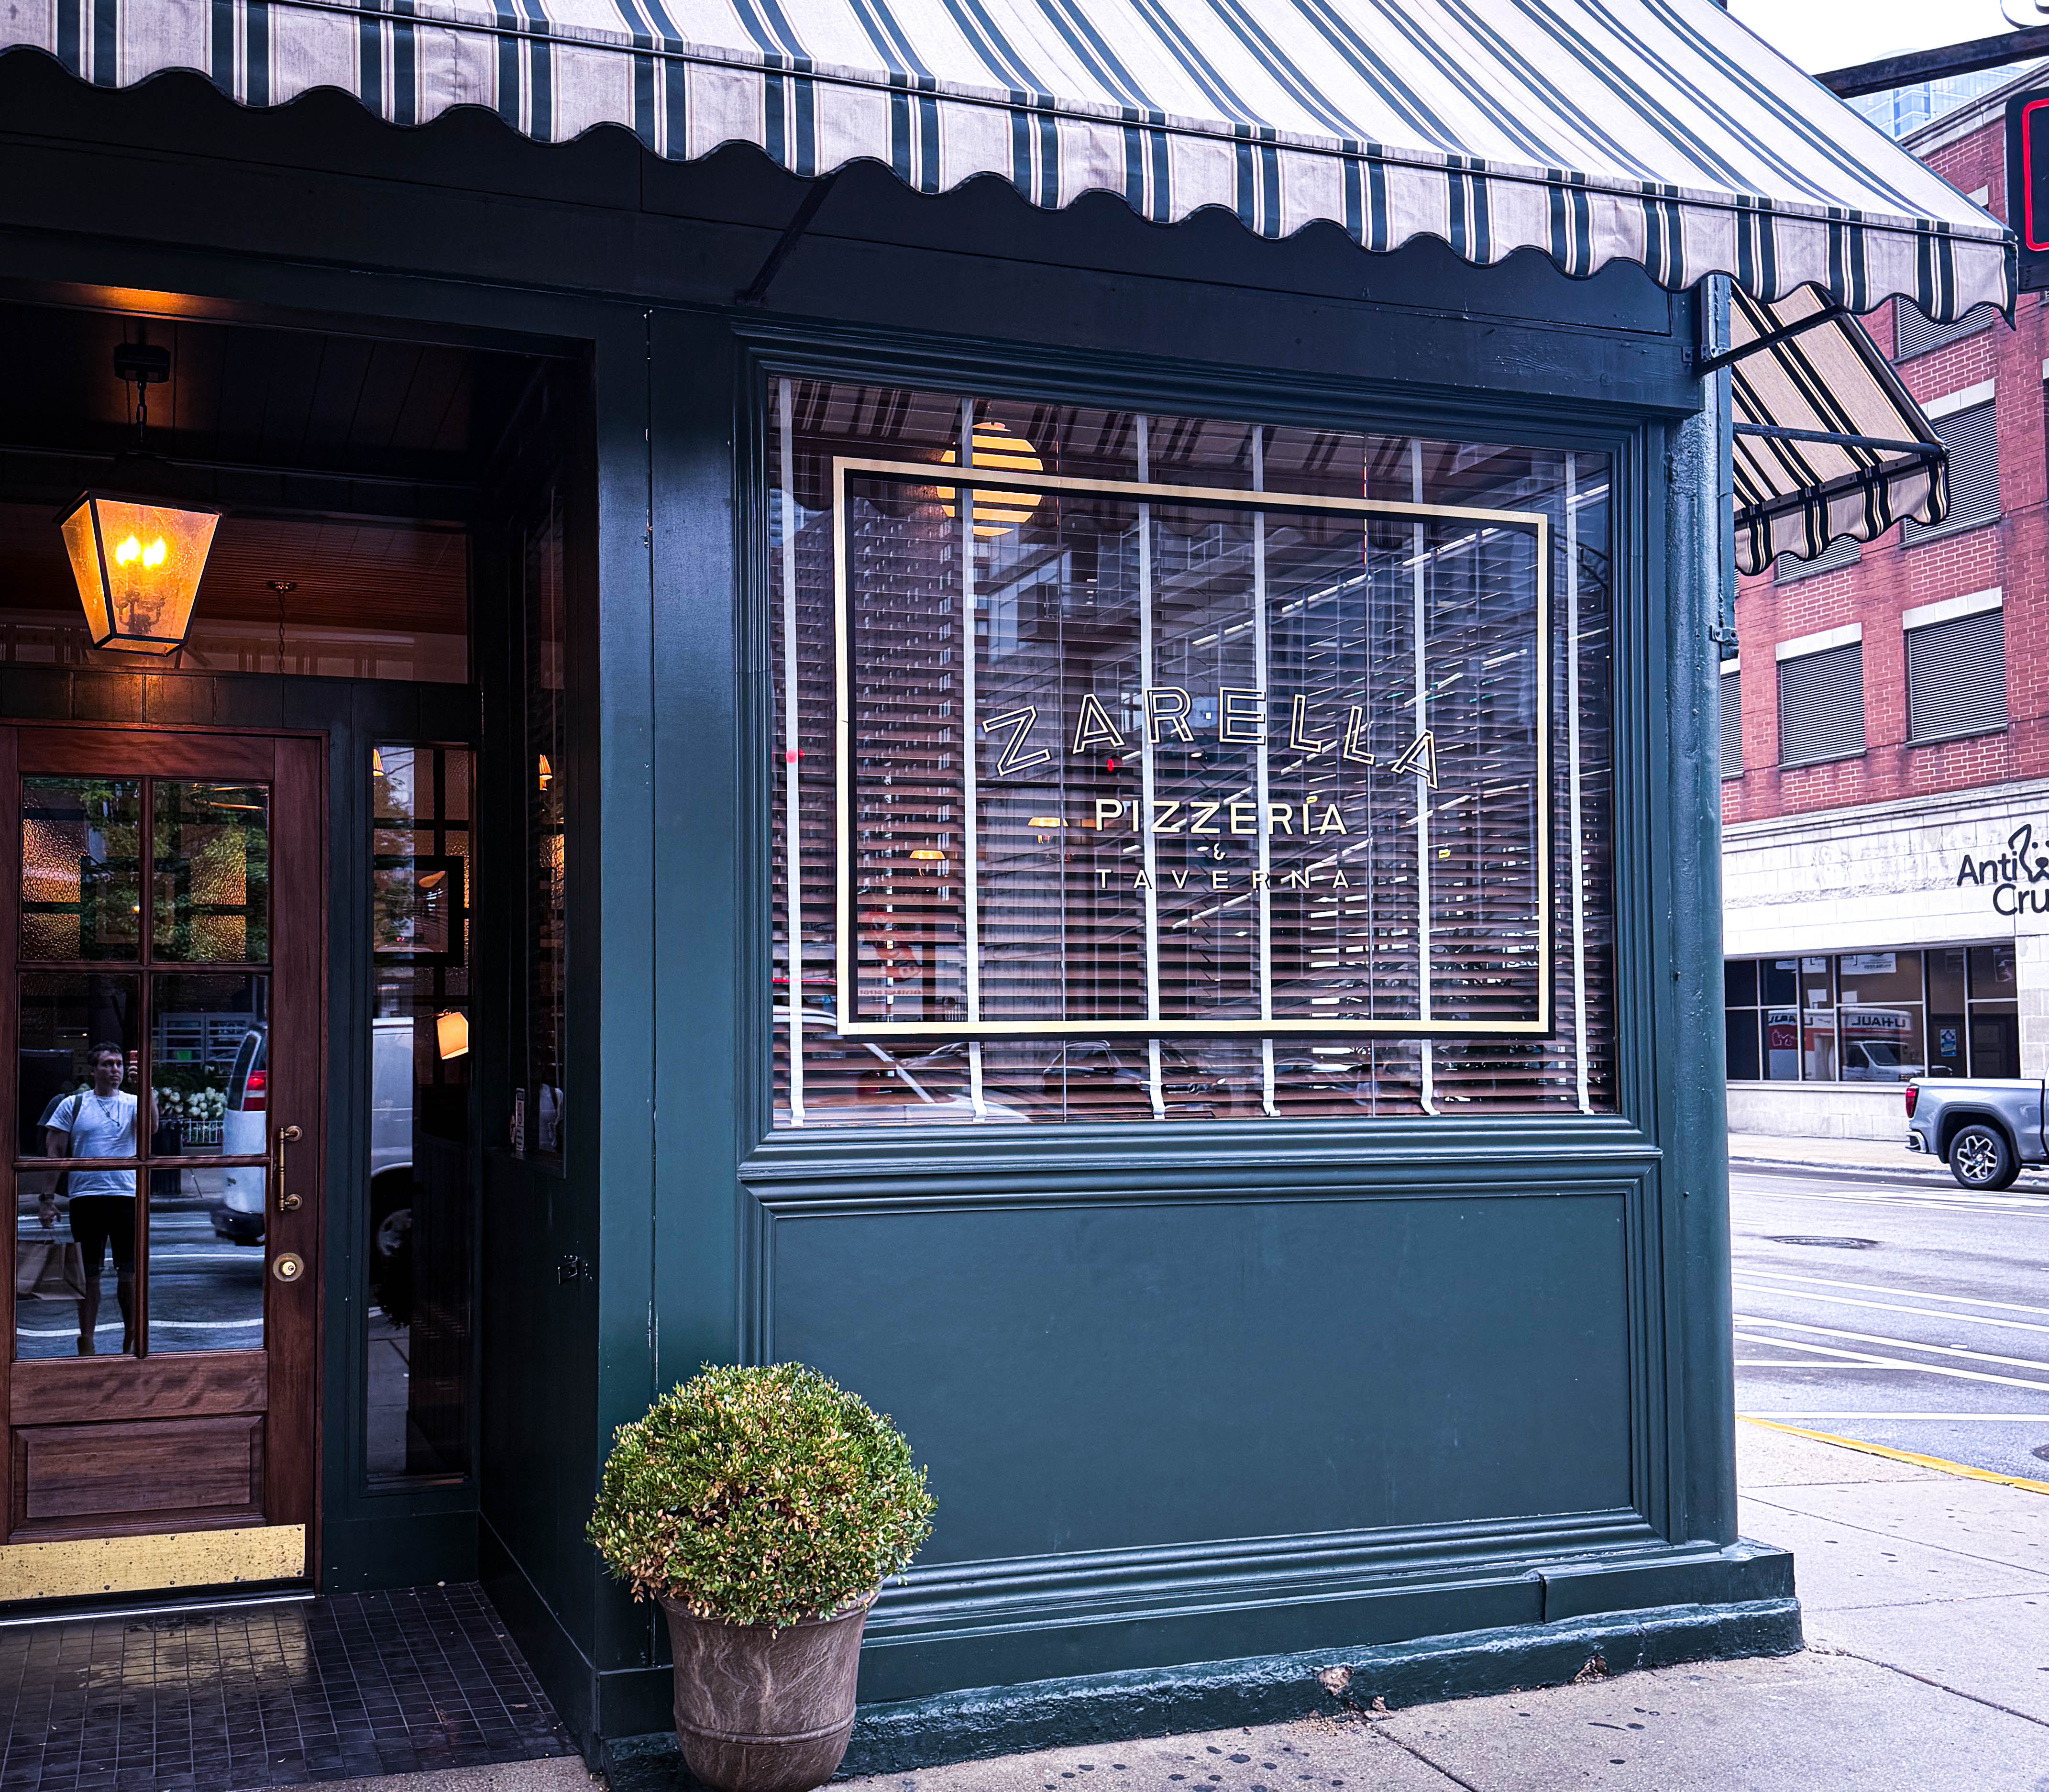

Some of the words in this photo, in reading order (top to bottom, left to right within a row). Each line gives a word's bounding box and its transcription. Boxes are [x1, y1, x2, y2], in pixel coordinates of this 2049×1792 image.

[983, 687, 1438, 789] ZARELLA
[1095, 799, 1347, 835] PIZZERIA
[1213, 843, 1226, 860] &
[1957, 851, 2017, 886] Anti
[1095, 869, 1349, 889] TAVERNA
[1993, 883, 2049, 916] Cru
